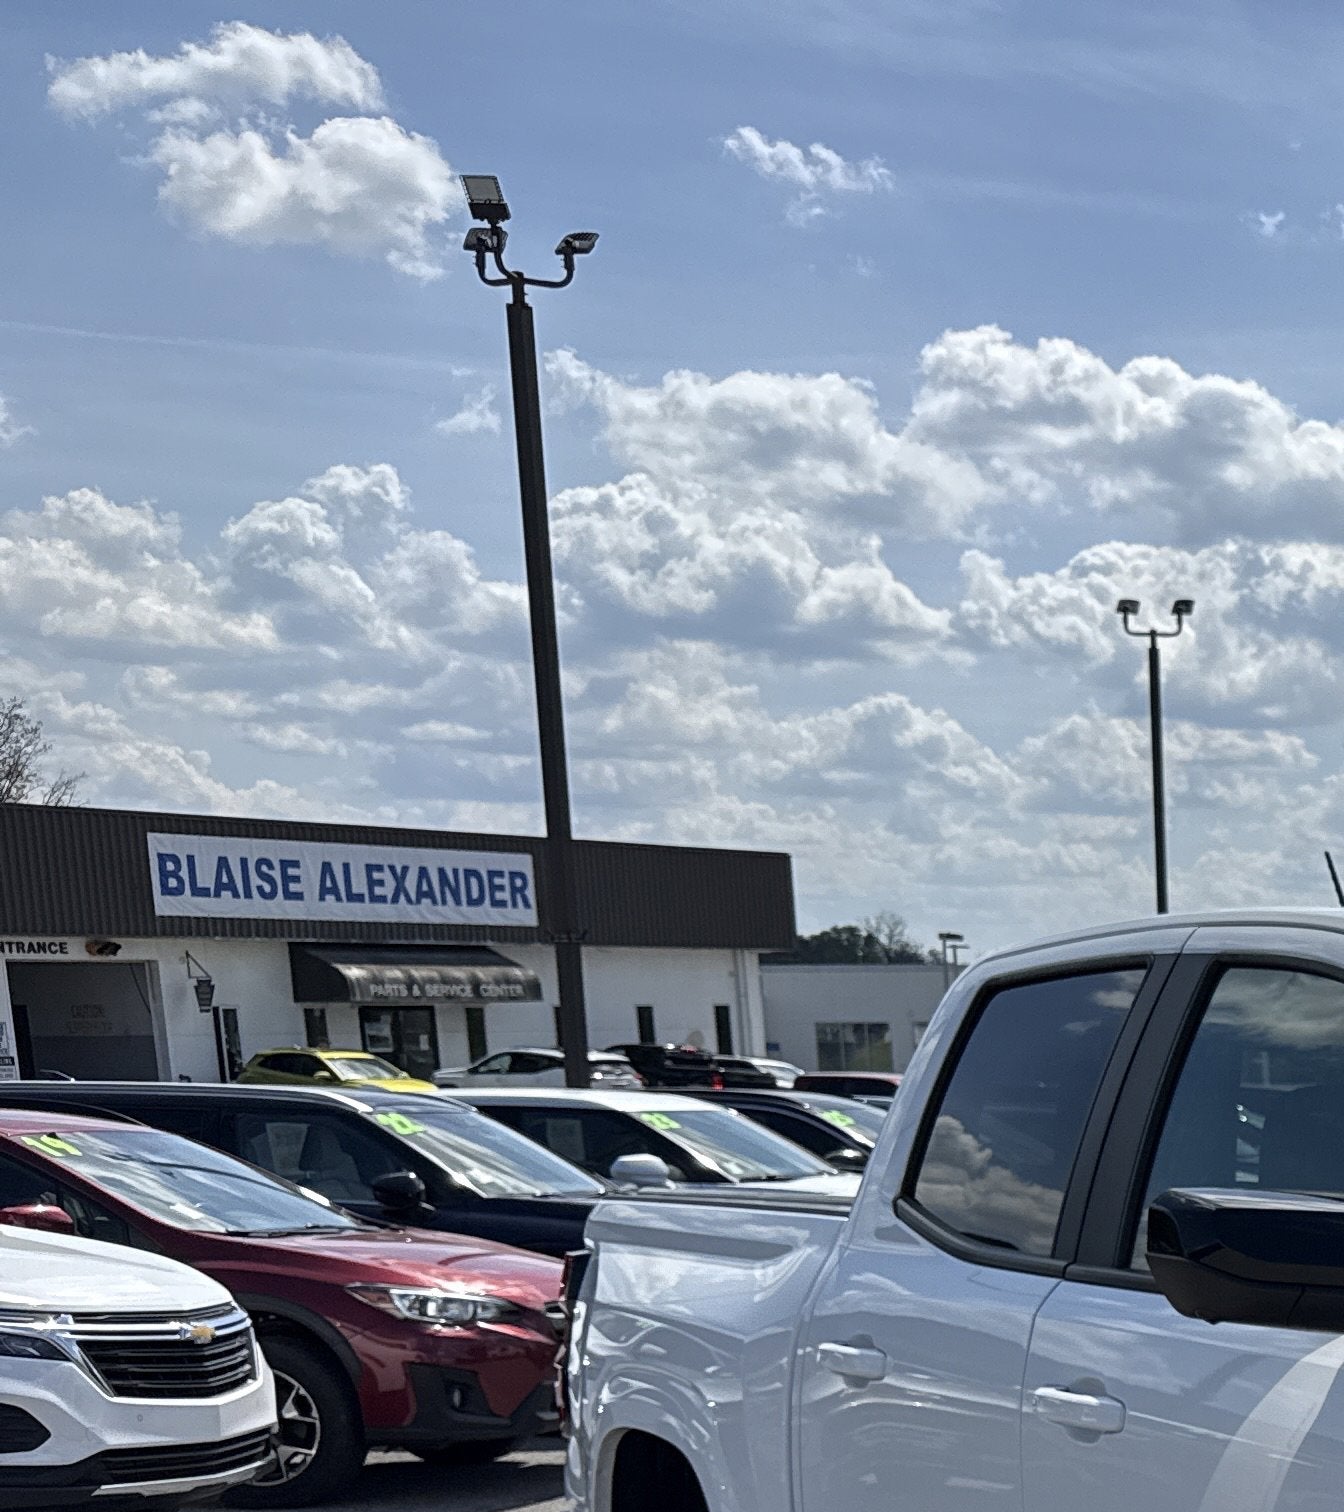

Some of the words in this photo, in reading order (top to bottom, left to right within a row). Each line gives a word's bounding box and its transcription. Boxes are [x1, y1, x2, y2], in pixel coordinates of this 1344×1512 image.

[156, 851, 304, 901] BLAISE
[318, 860, 532, 910] ALEXANDER
[369, 983, 408, 997] PARTS
[412, 983, 421, 997] &
[425, 983, 474, 997] SERVICE
[479, 983, 524, 997] CENTER
